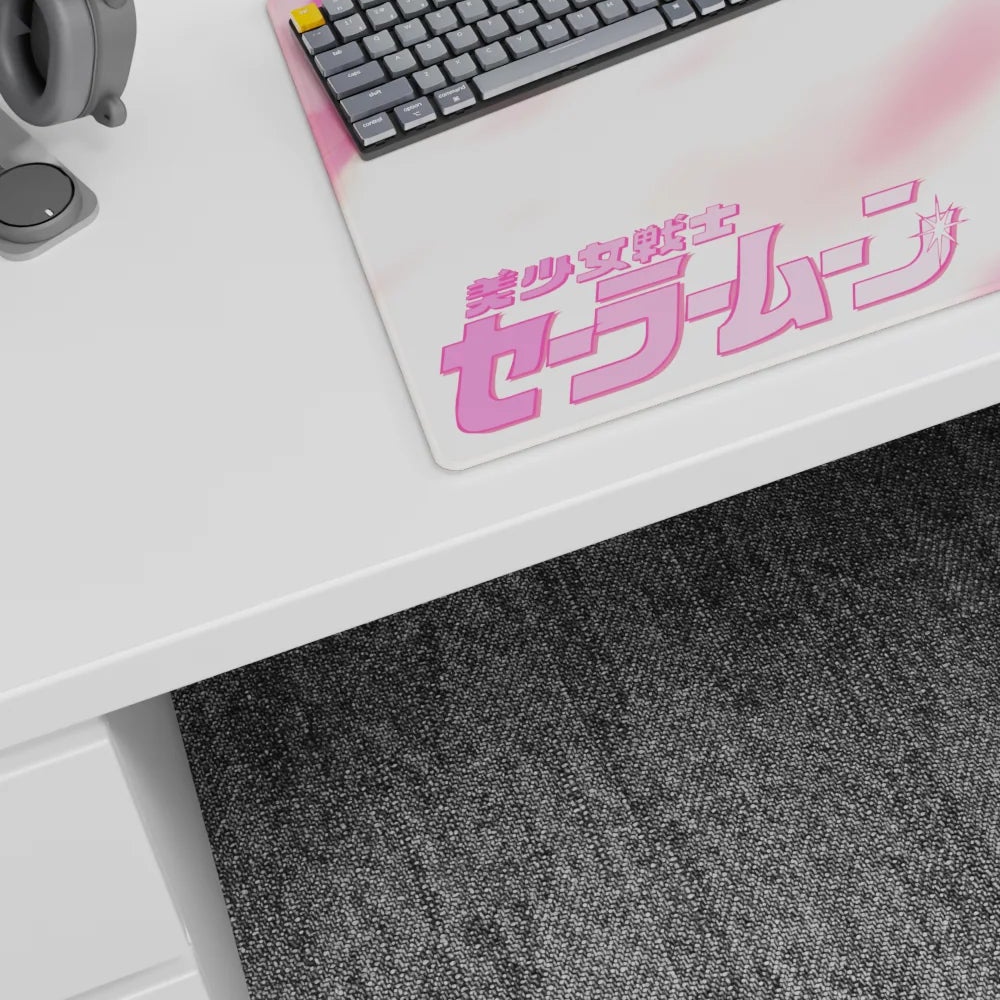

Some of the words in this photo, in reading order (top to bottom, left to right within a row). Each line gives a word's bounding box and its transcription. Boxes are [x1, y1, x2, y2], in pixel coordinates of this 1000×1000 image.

[403, 102, 423, 113] option
[438, 84, 467, 99] command
[465, 203, 739, 318] 美少女戦士
[440, 180, 960, 434] セーラームーン
